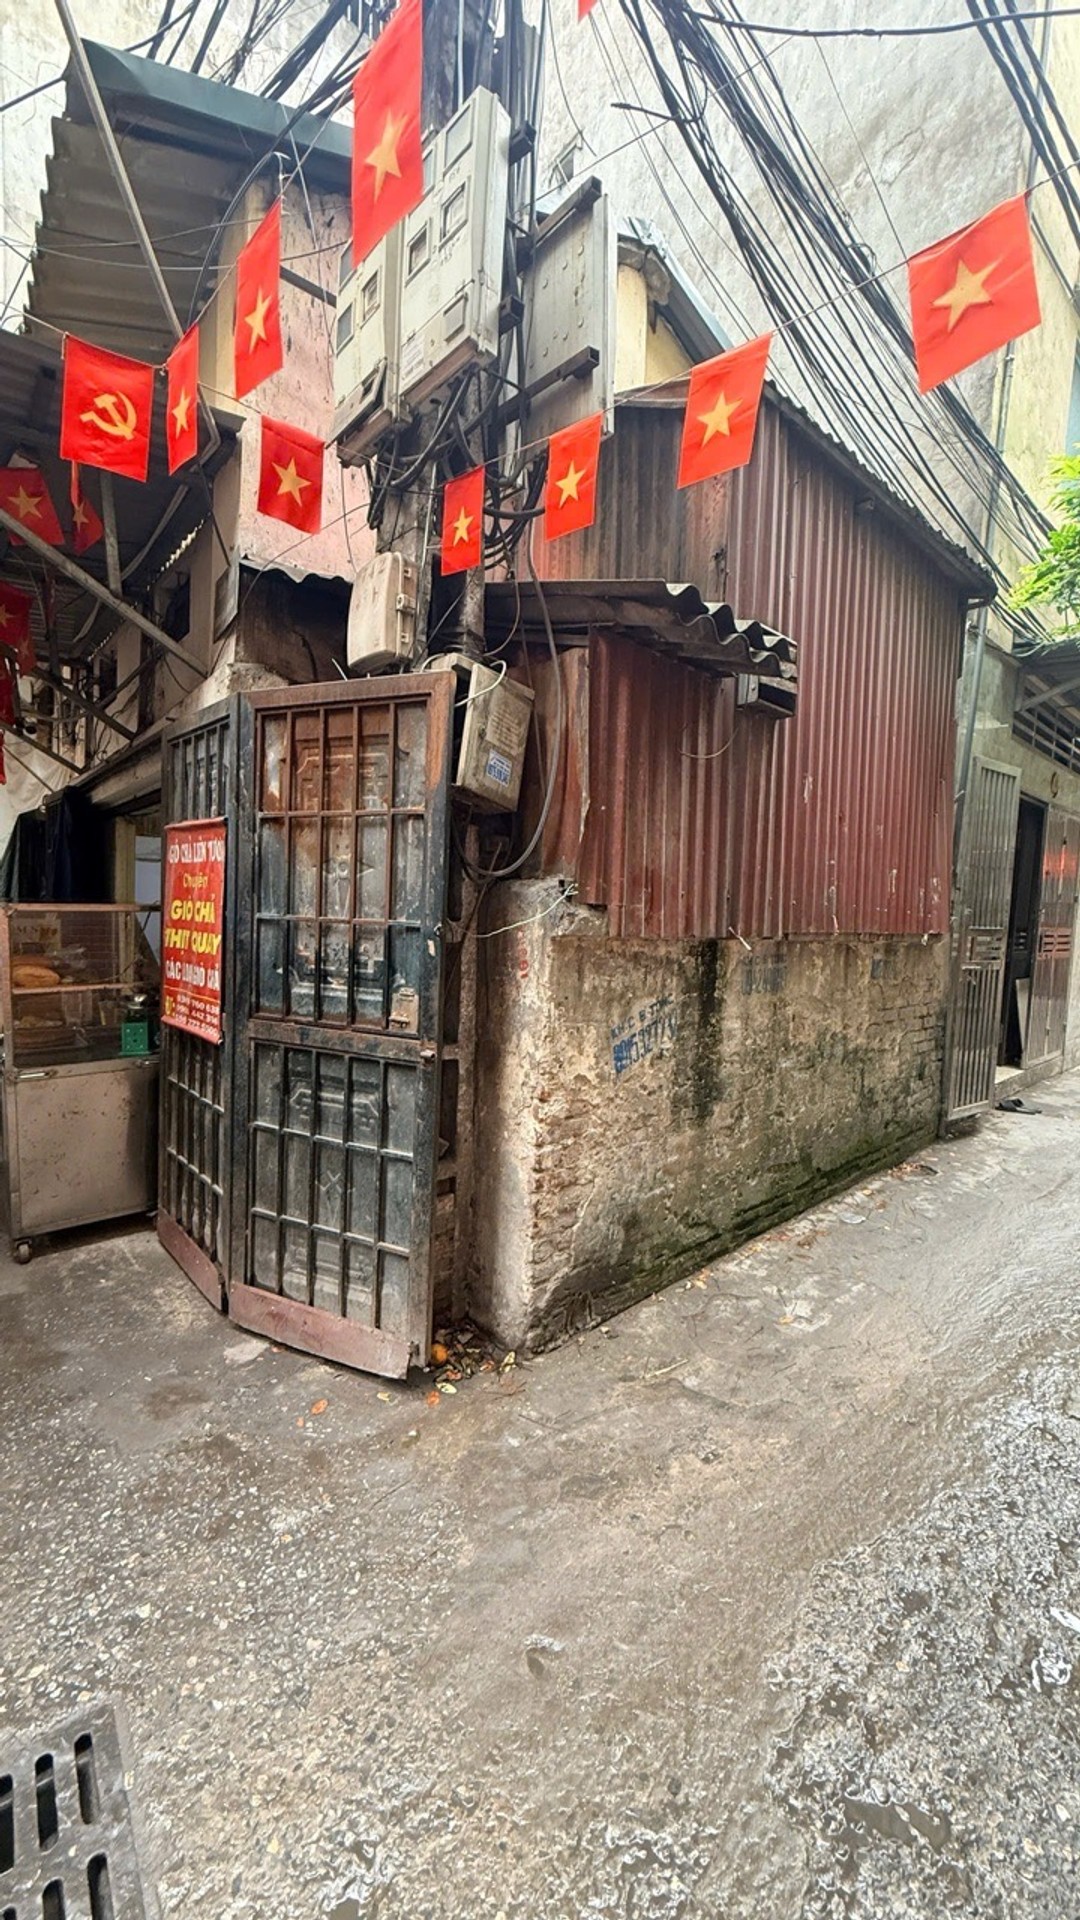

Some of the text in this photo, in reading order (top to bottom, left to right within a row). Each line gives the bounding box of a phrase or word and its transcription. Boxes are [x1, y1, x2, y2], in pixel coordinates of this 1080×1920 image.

[171, 893, 216, 924] GIÒ CHẢ
[164, 928, 222, 955] THỊT QUAY
